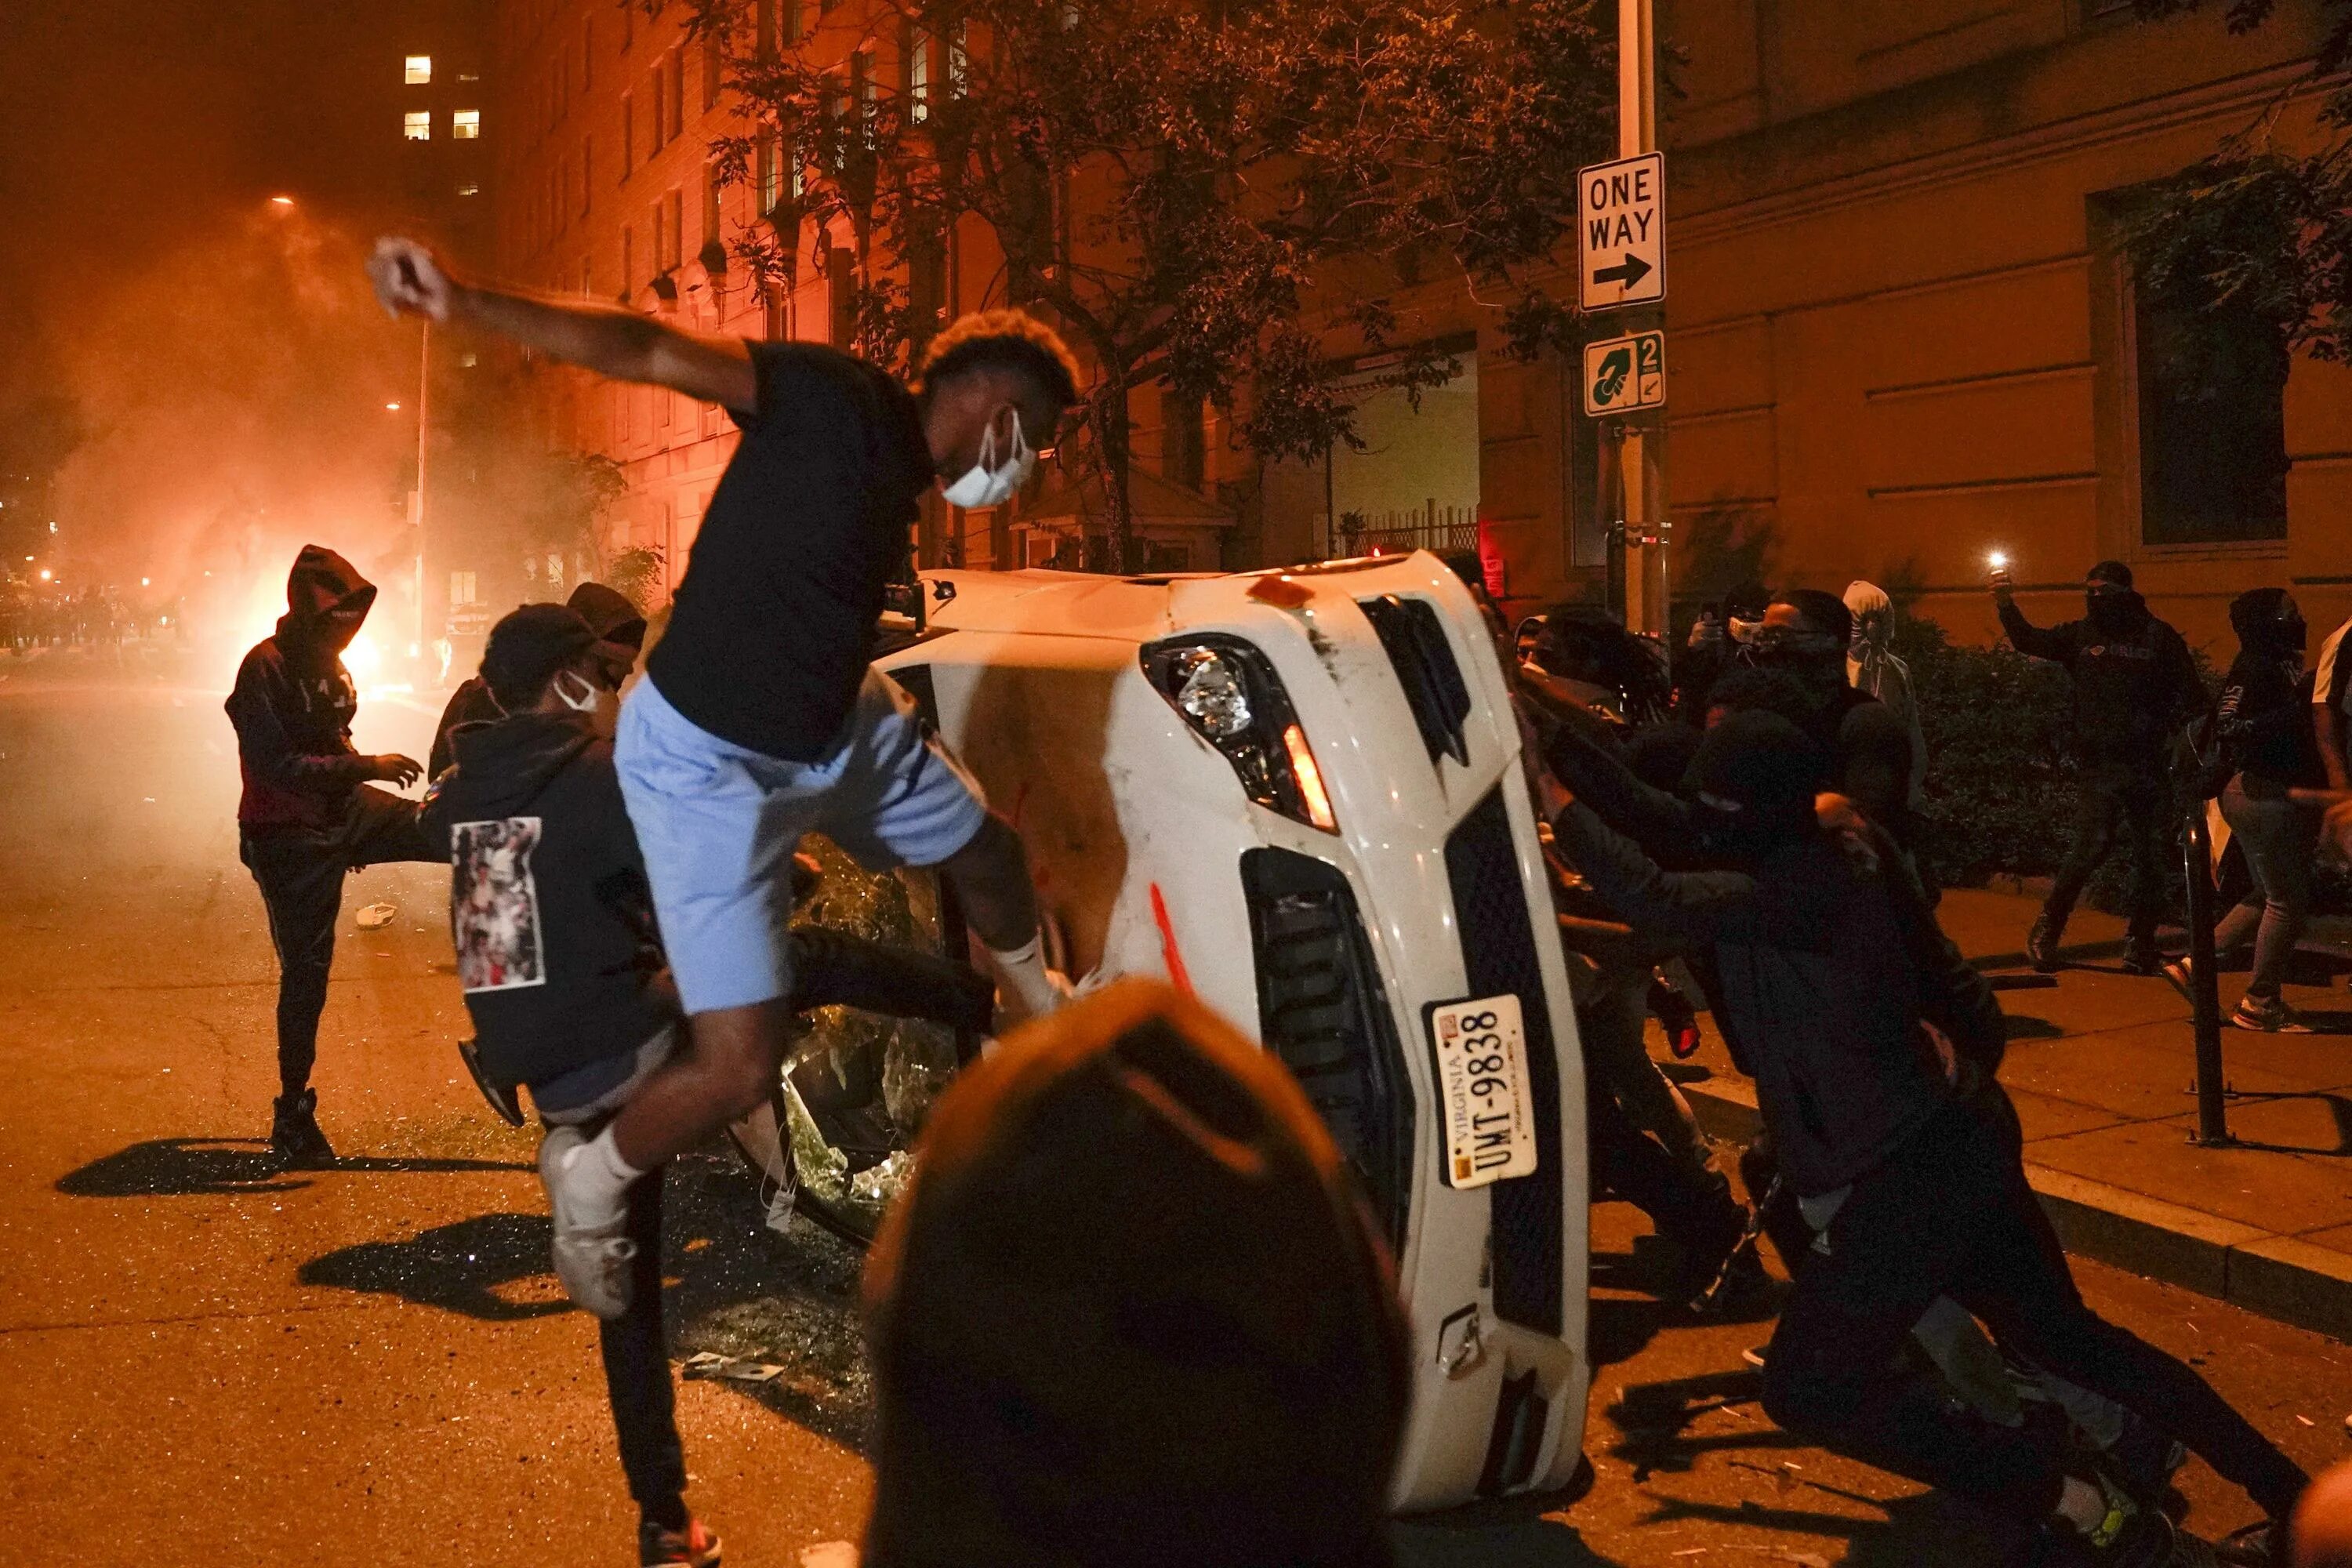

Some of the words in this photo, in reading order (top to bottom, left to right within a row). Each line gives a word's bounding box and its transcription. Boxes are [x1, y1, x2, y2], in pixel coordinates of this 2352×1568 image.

[1591, 169, 1651, 210] ONE
[1589, 208, 1653, 251] WAY
[1642, 338, 1657, 367] 2
[1447, 1054, 1468, 1142] VIRGINIA
[1461, 1011, 1512, 1172] UMT-9838
